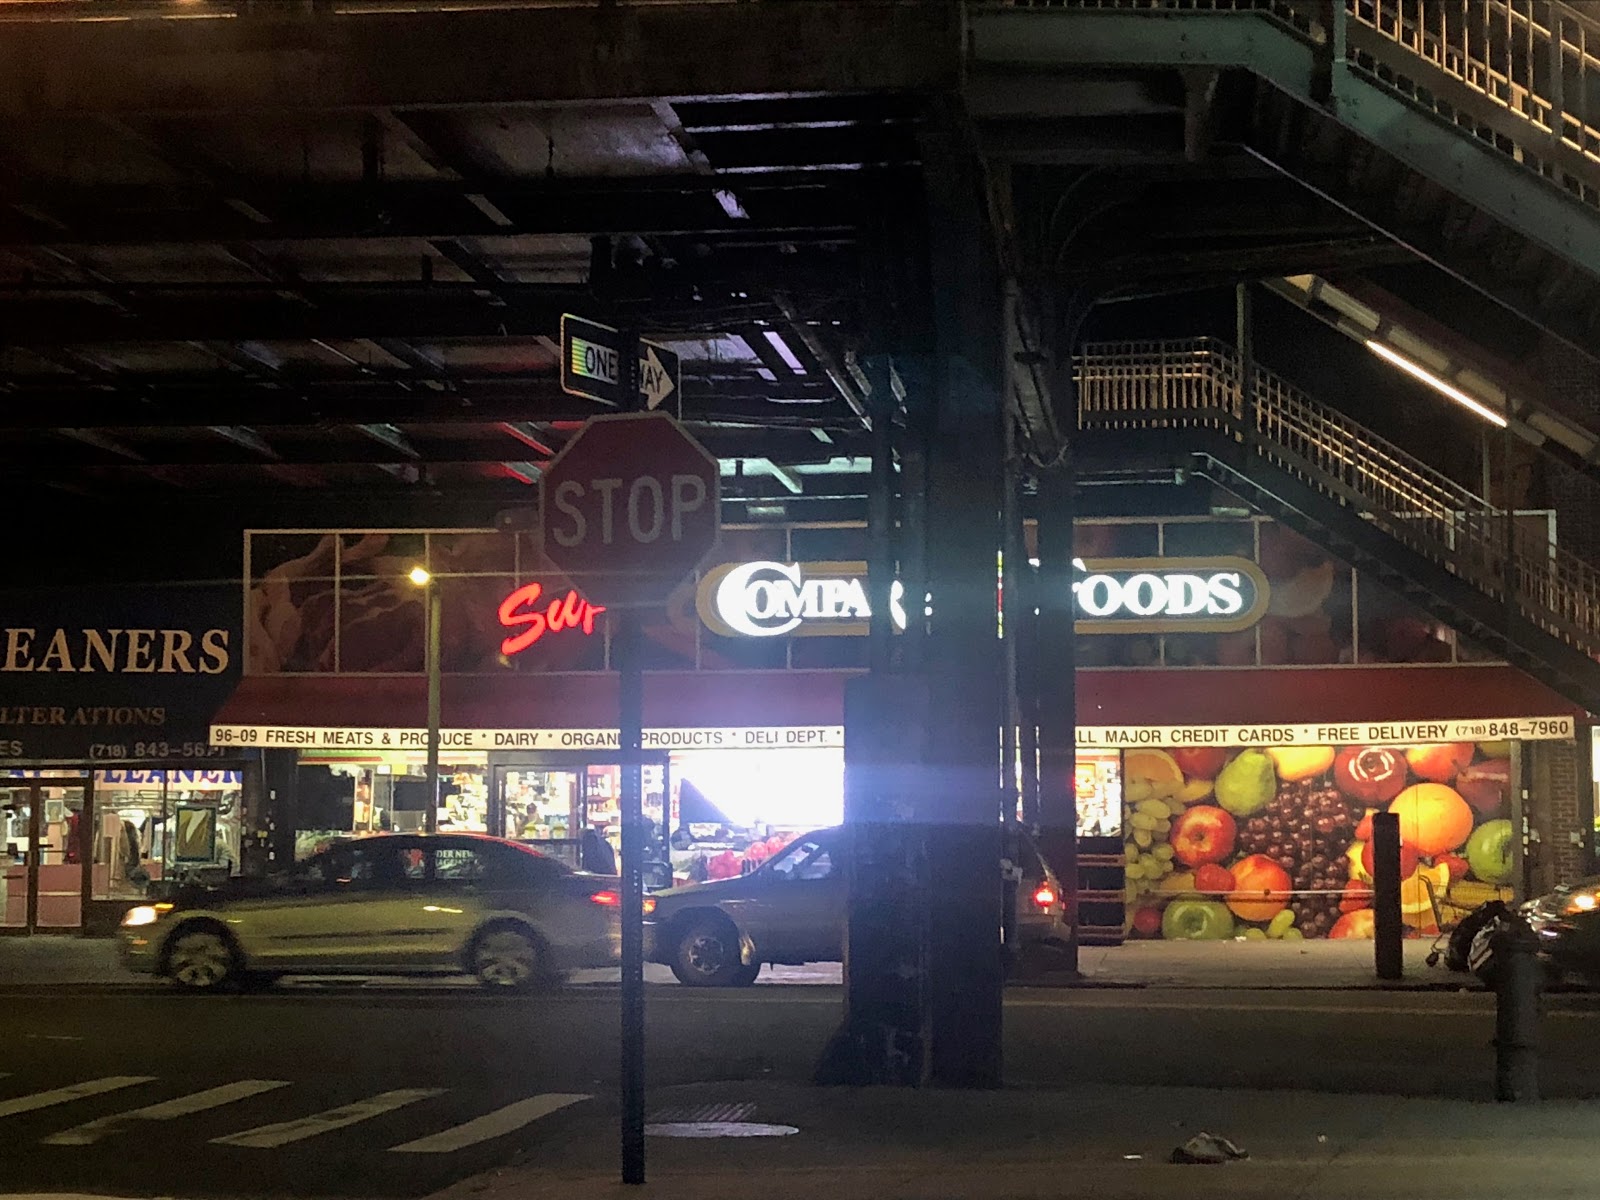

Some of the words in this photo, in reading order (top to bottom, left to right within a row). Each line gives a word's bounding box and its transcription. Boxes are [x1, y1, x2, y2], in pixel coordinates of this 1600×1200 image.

[586, 346, 620, 381] ONE
[552, 474, 707, 548] STOP
[1072, 558, 1243, 616] OODS
[0, 628, 230, 674] EANERS
[215, 728, 258, 742] 96-09
[265, 730, 316, 744] FRESH
[323, 731, 374, 745] MEATS
[381, 732, 391, 745] &
[494, 732, 539, 746] DAIRY
[641, 731, 723, 745] PRODUCTS
[745, 731, 779, 744] DELI
[786, 730, 828, 744] DEPT.
[1075, 730, 1098, 743] LL
[1105, 730, 1162, 743] MAJOR
[1170, 729, 1229, 743] CREDIT
[1238, 728, 1295, 742] CARDS
[1318, 727, 1360, 741] FREE
[1368, 724, 1449, 740] DELIVERY
[1455, 724, 1487, 737] (718)
[1489, 720, 1569, 737] 848-7960
[89, 743, 127, 758] (718)
